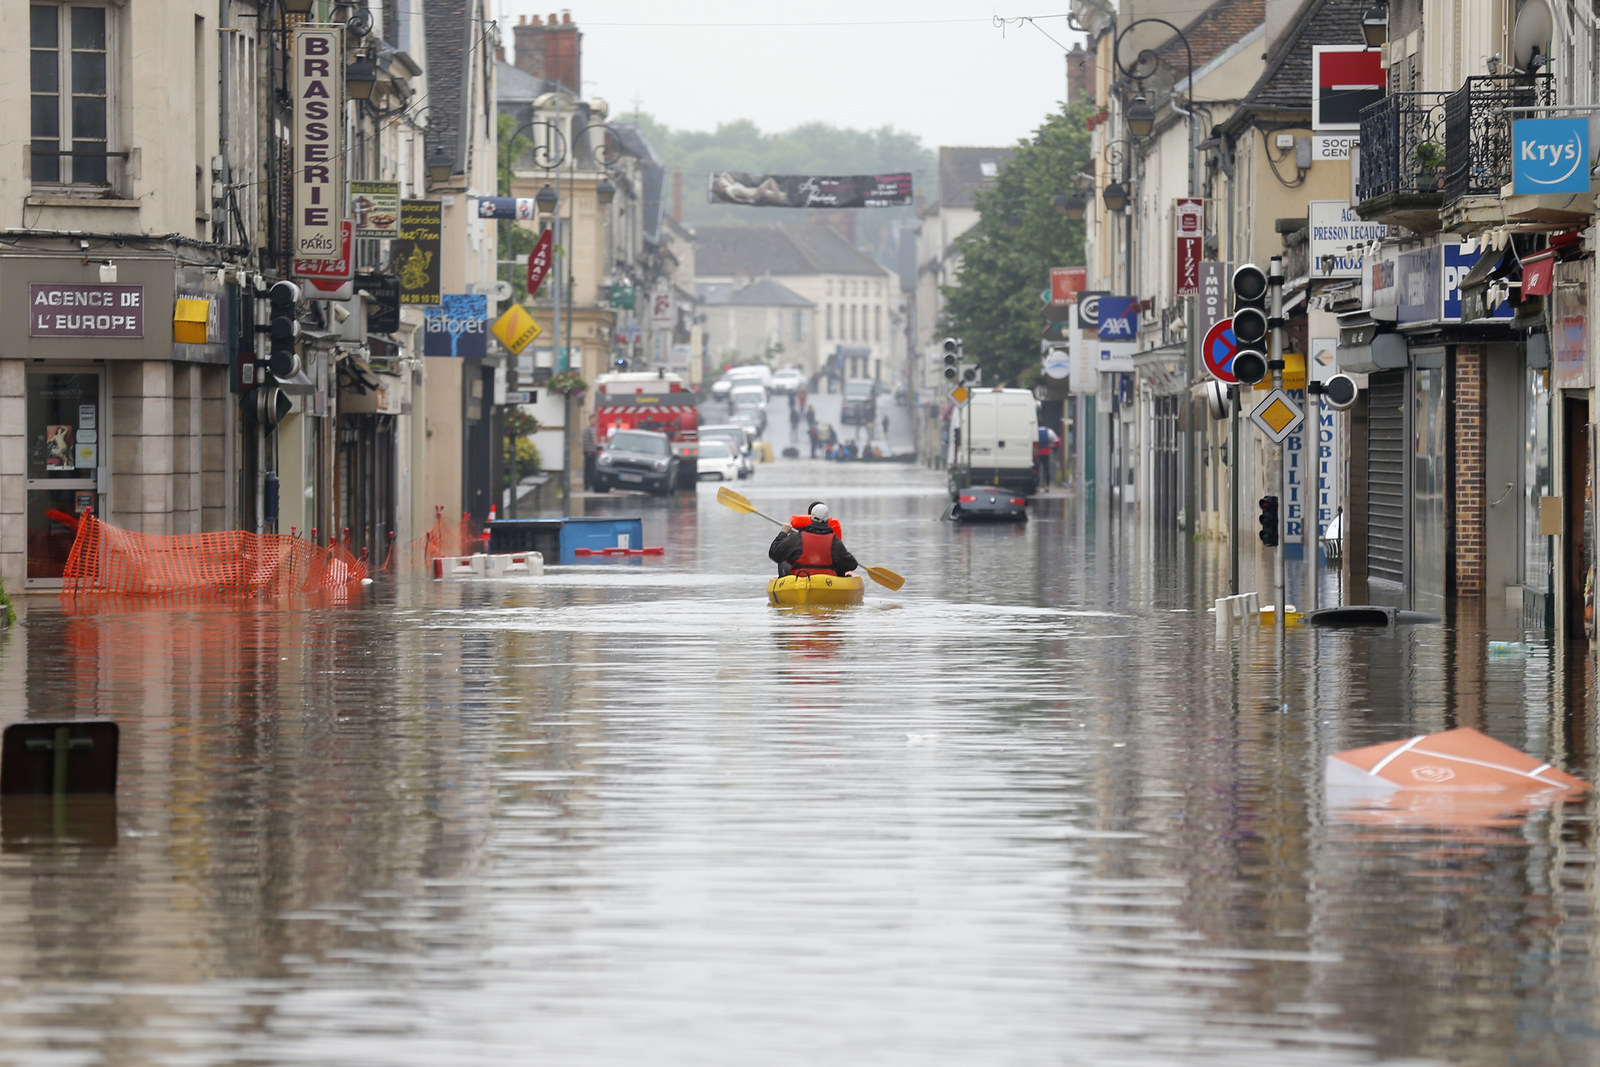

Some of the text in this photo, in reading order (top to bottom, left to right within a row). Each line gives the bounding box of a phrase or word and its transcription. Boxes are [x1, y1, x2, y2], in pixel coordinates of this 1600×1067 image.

[303, 37, 330, 226] BRASSERIE
[1521, 140, 1576, 167] Krys
[1313, 227, 1349, 241] PRESSON
[301, 239, 333, 250] PARIS
[296, 259, 347, 274] 24/24
[531, 243, 549, 282] TABAC
[1184, 239, 1195, 286] PIZZA
[1315, 256, 1363, 270] IMOB
[34, 291, 140, 307] AGENCE DE
[425, 315, 485, 334] laforêt
[1098, 317, 1132, 335] AXA
[511, 325, 538, 351] PRESSE
